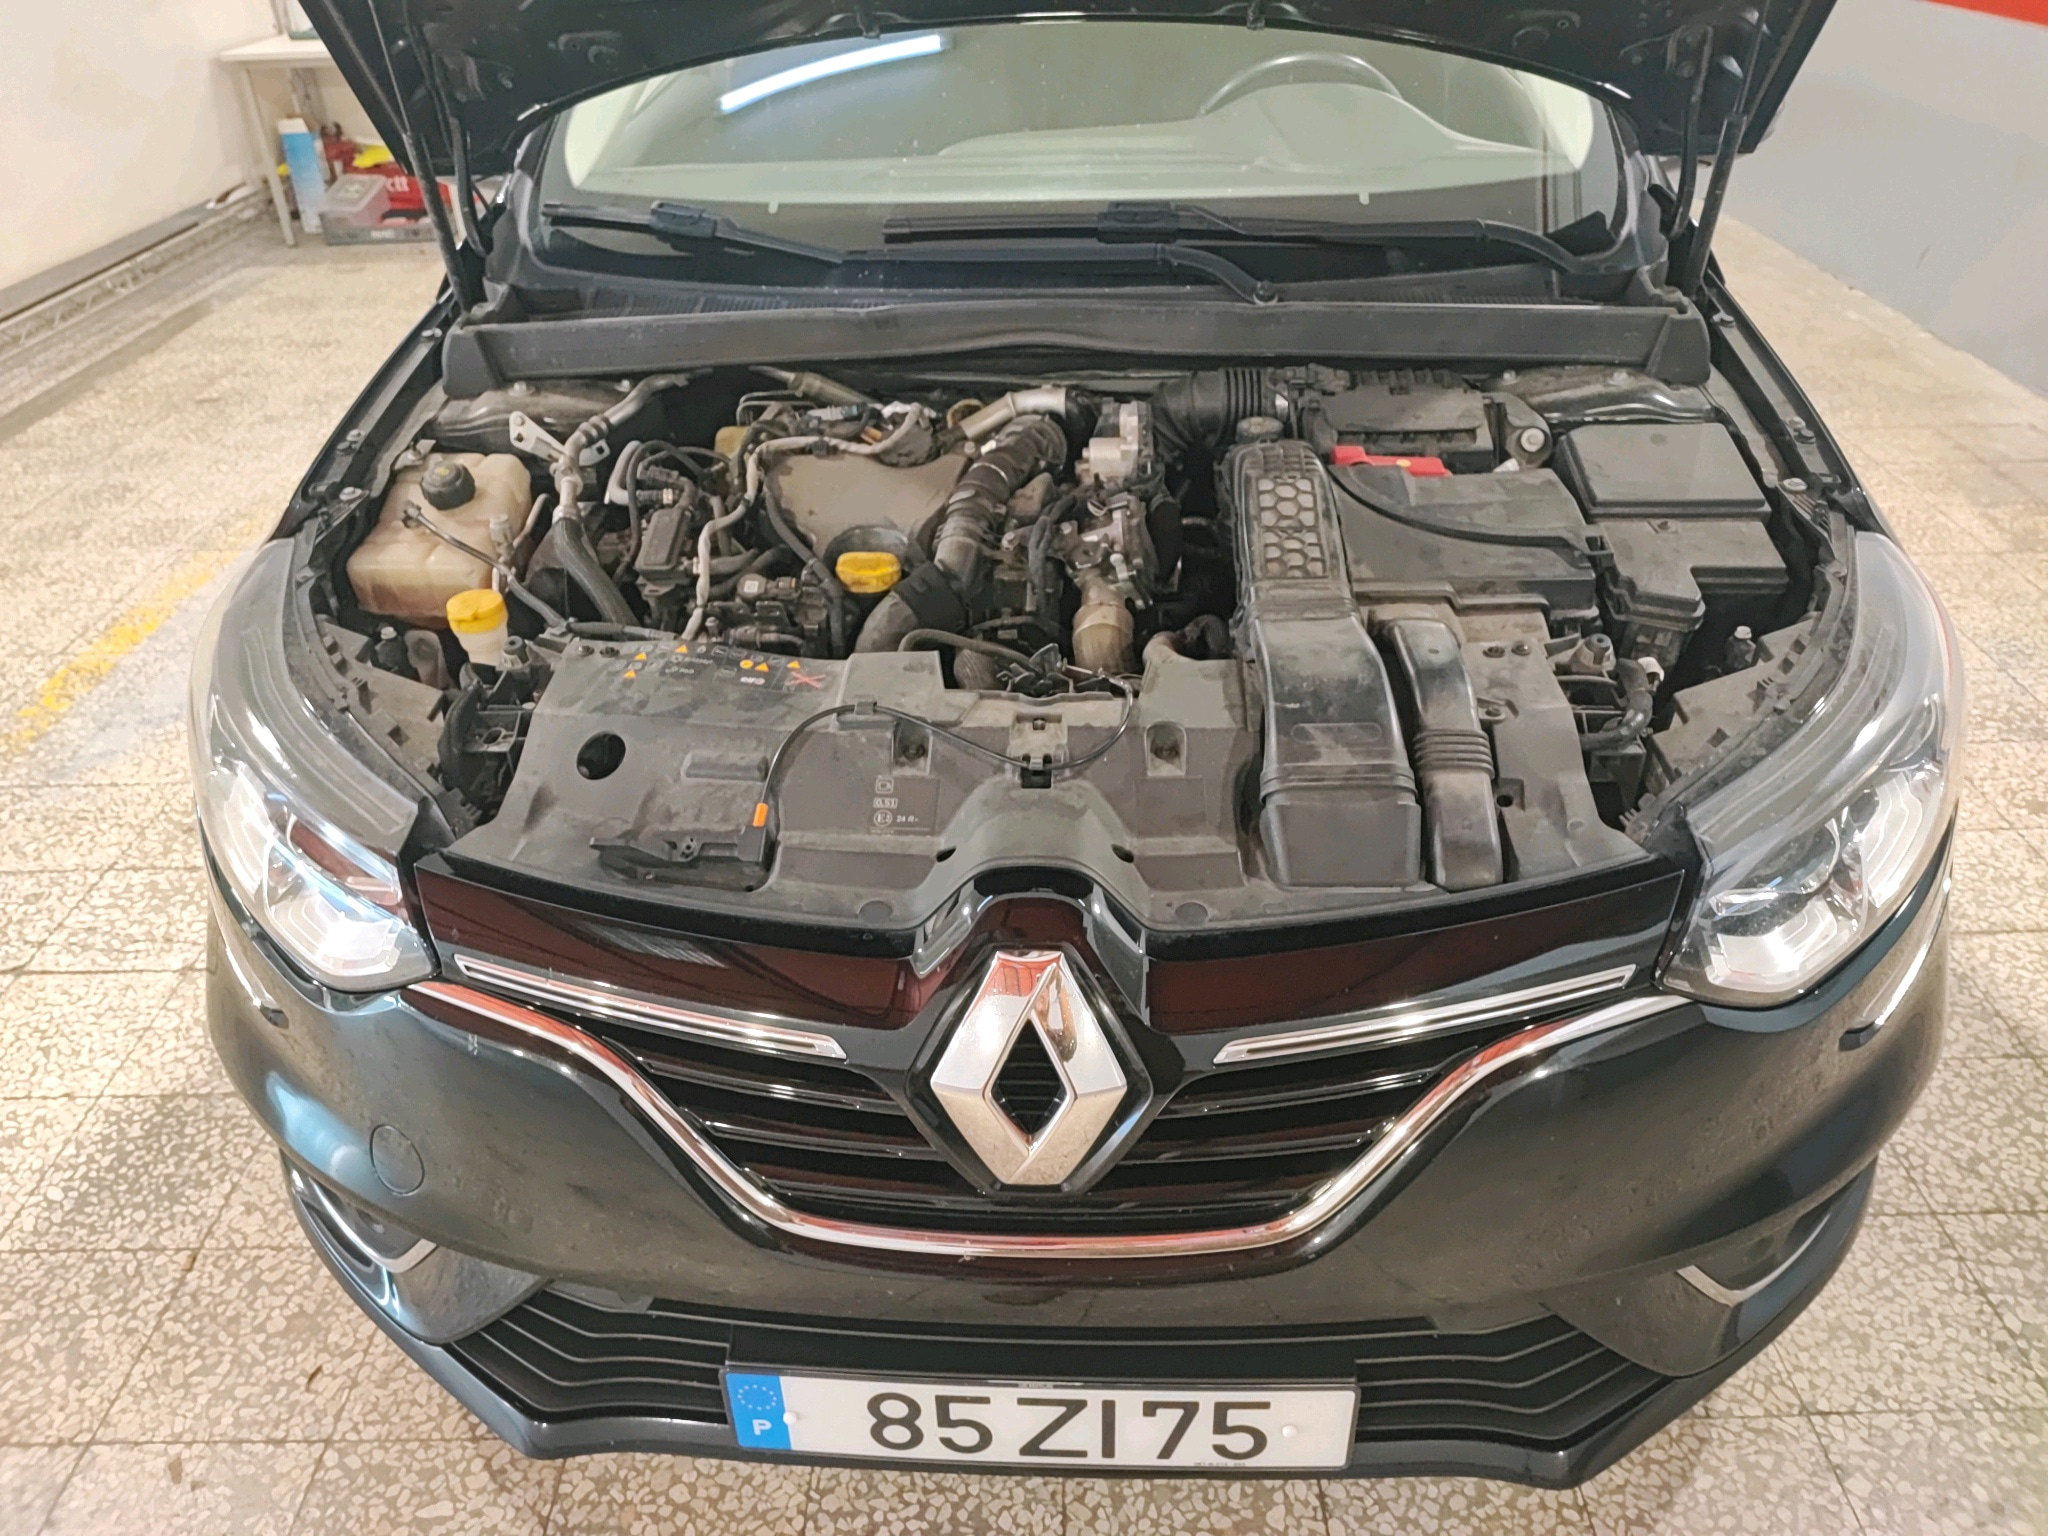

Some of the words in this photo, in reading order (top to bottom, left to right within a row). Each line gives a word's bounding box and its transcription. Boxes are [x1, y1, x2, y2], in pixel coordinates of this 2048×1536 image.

[752, 1419, 772, 1436] P
[866, 1392, 993, 1454] 85
[1142, 1400, 1271, 1461] 75
